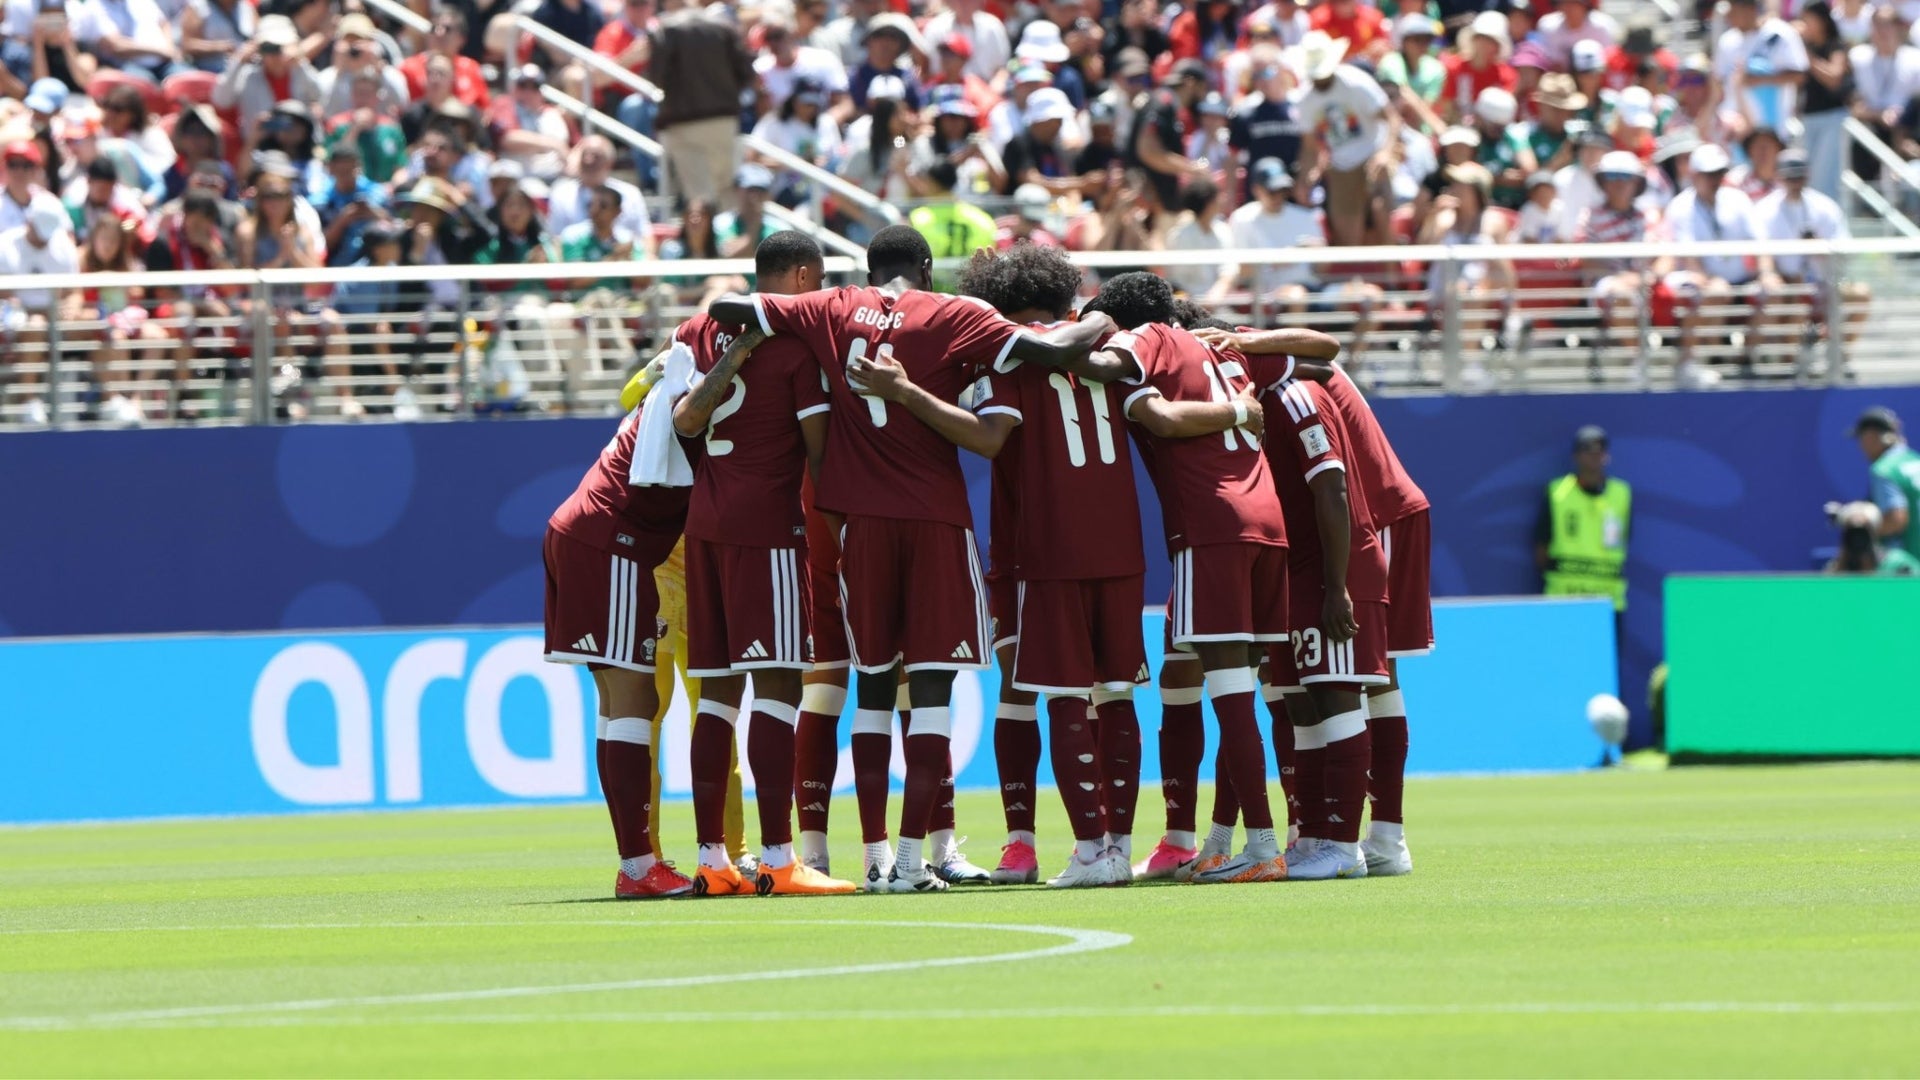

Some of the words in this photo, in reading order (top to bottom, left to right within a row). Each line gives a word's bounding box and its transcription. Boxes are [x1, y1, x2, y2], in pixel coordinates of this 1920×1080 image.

[846, 337, 894, 428] 4
[705, 373, 746, 456] 2
[1049, 372, 1116, 467] 11
[1291, 627, 1321, 670] 23
[250, 636, 984, 804] arao
[802, 780, 827, 791] QFA
[1005, 782, 1027, 791] QFA
[1162, 778, 1179, 786] FA
